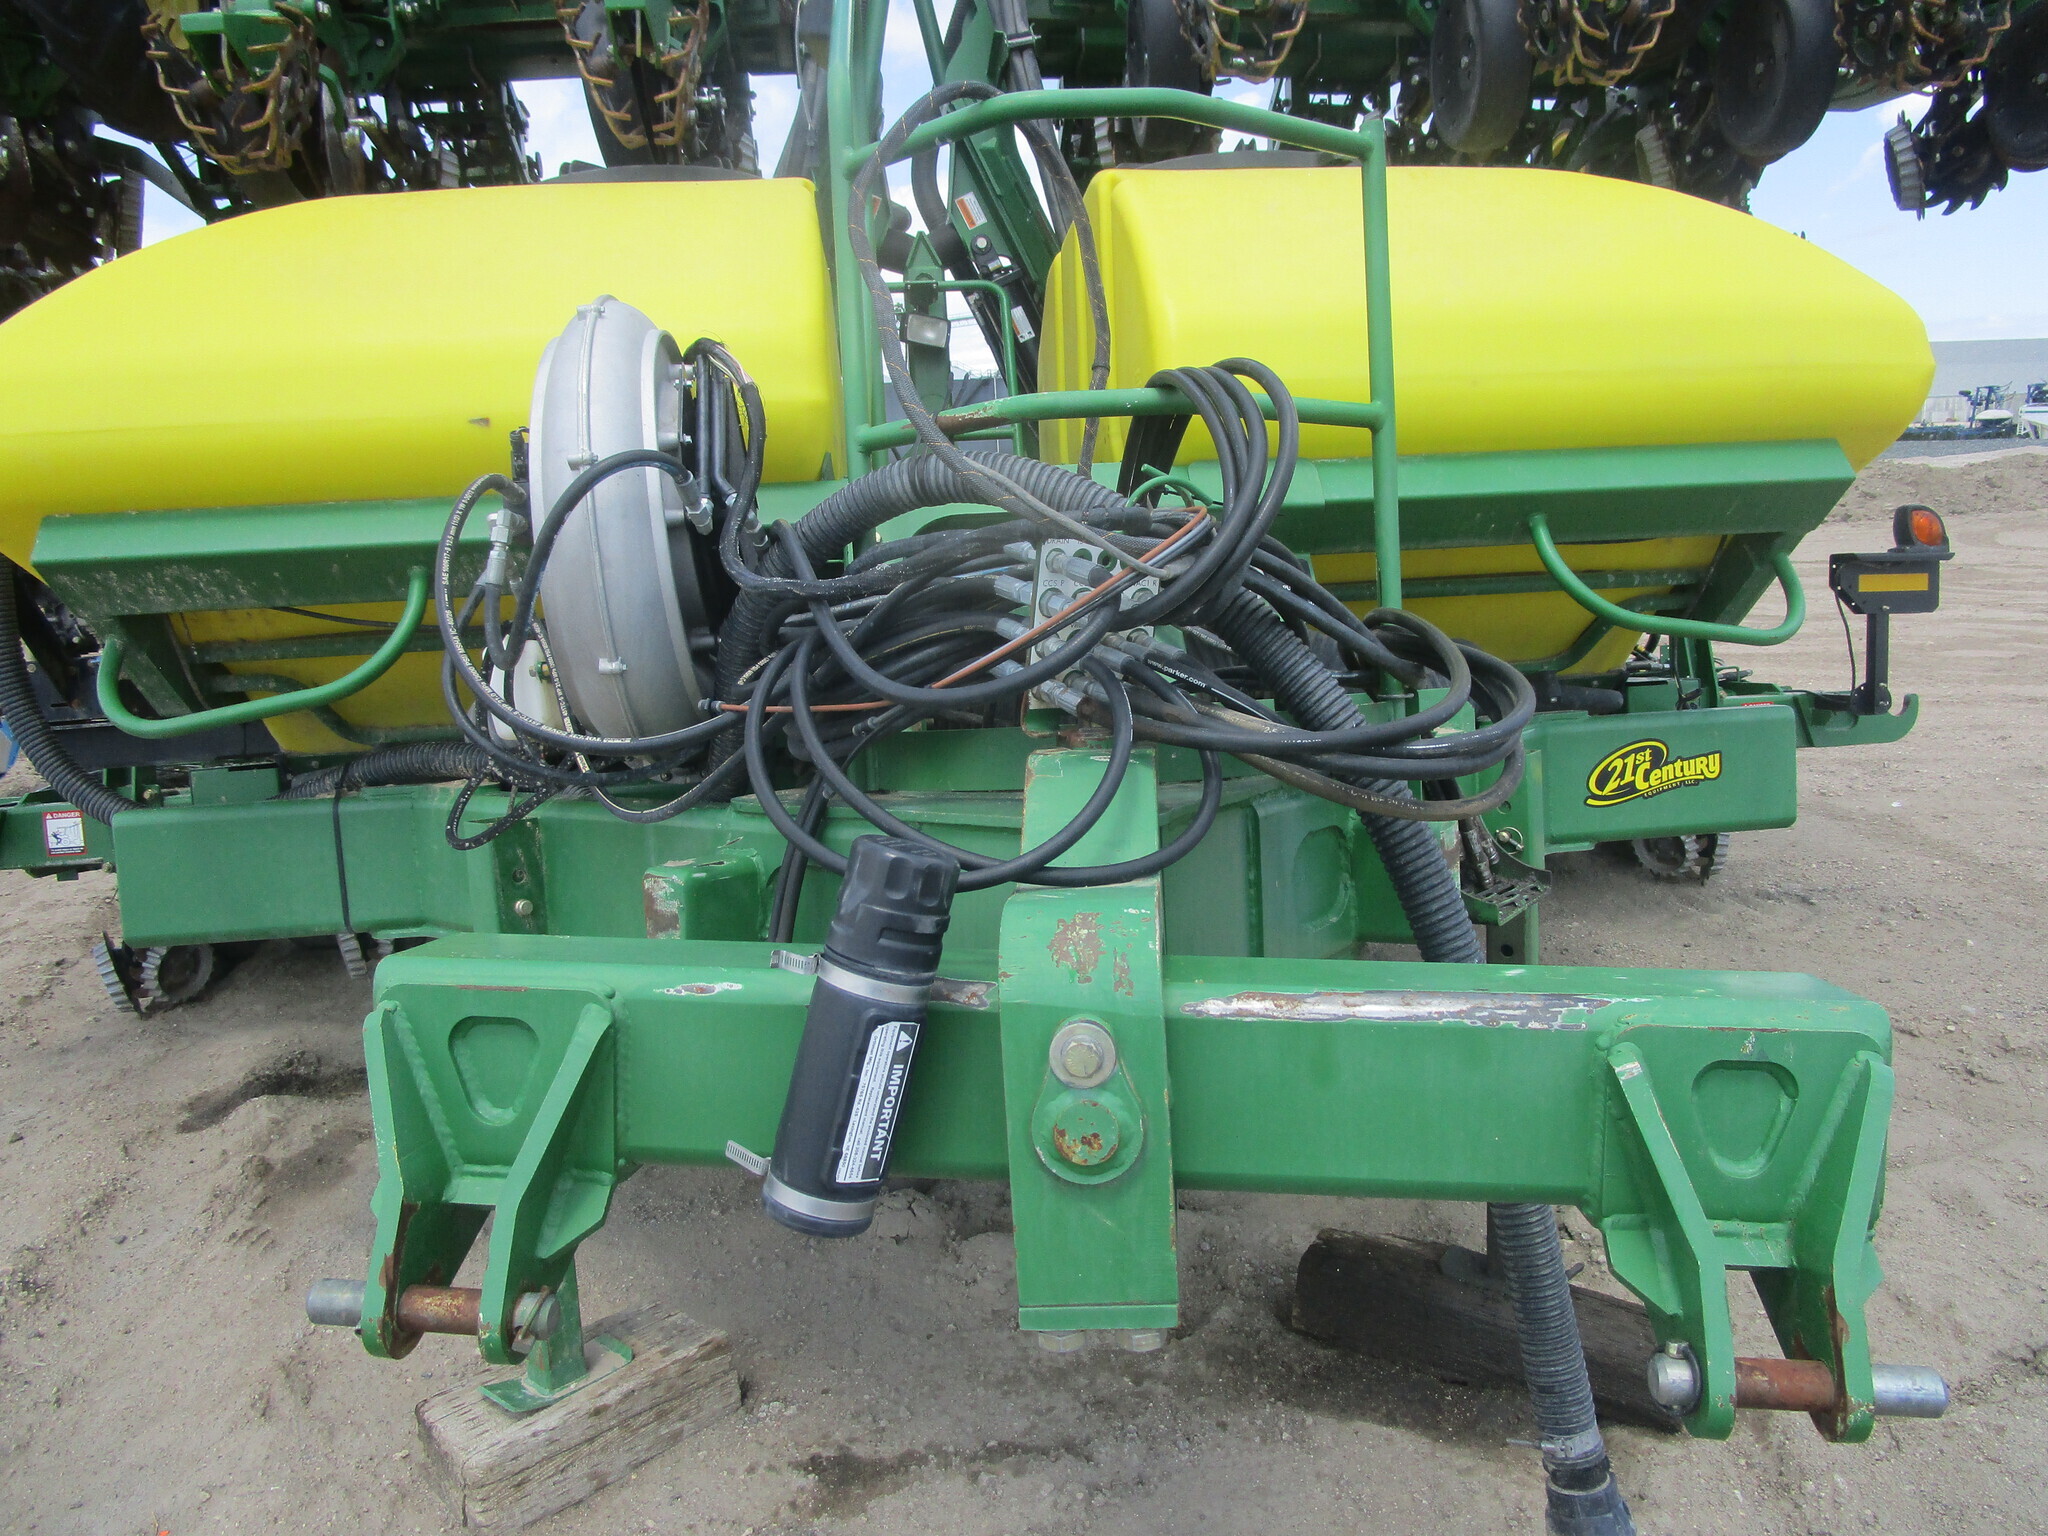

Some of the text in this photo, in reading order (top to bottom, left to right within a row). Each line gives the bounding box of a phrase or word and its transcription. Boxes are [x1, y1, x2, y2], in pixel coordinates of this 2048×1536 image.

[452, 635, 465, 655] MSHA
[1147, 659, 1206, 688] www.parker.com
[479, 680, 492, 693] MPa
[1602, 748, 1652, 795] 21st
[52, 811, 81, 819] DANGER
[869, 1064, 904, 1160] IMPORTANT
